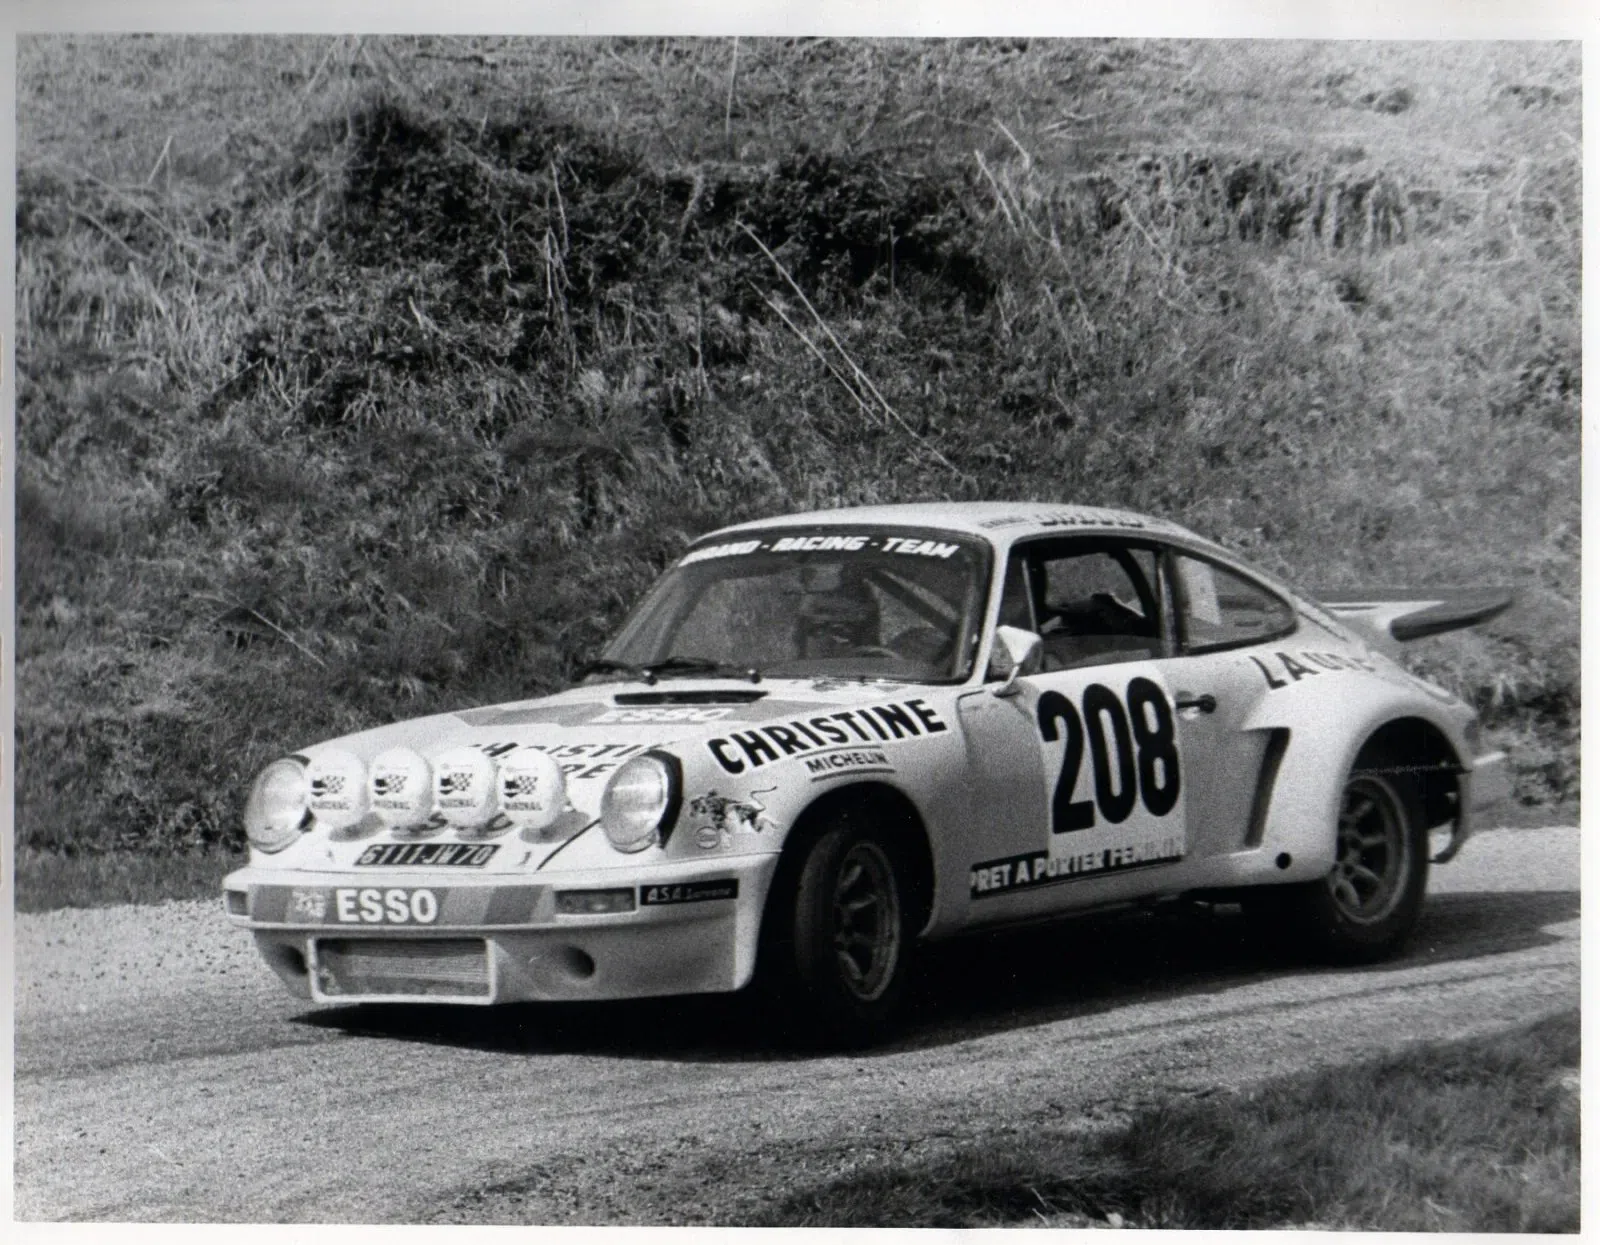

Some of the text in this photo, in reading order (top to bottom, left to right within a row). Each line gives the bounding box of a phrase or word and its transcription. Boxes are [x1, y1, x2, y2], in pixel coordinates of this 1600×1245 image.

[771, 537, 869, 552] RACING
[881, 537, 960, 558] TEAM
[708, 698, 947, 775] CHRISTINE
[805, 752, 888, 772] MICHELIN
[1036, 676, 1181, 834] 208
[1015, 860, 1030, 884] A
[336, 888, 438, 923] ESSO
